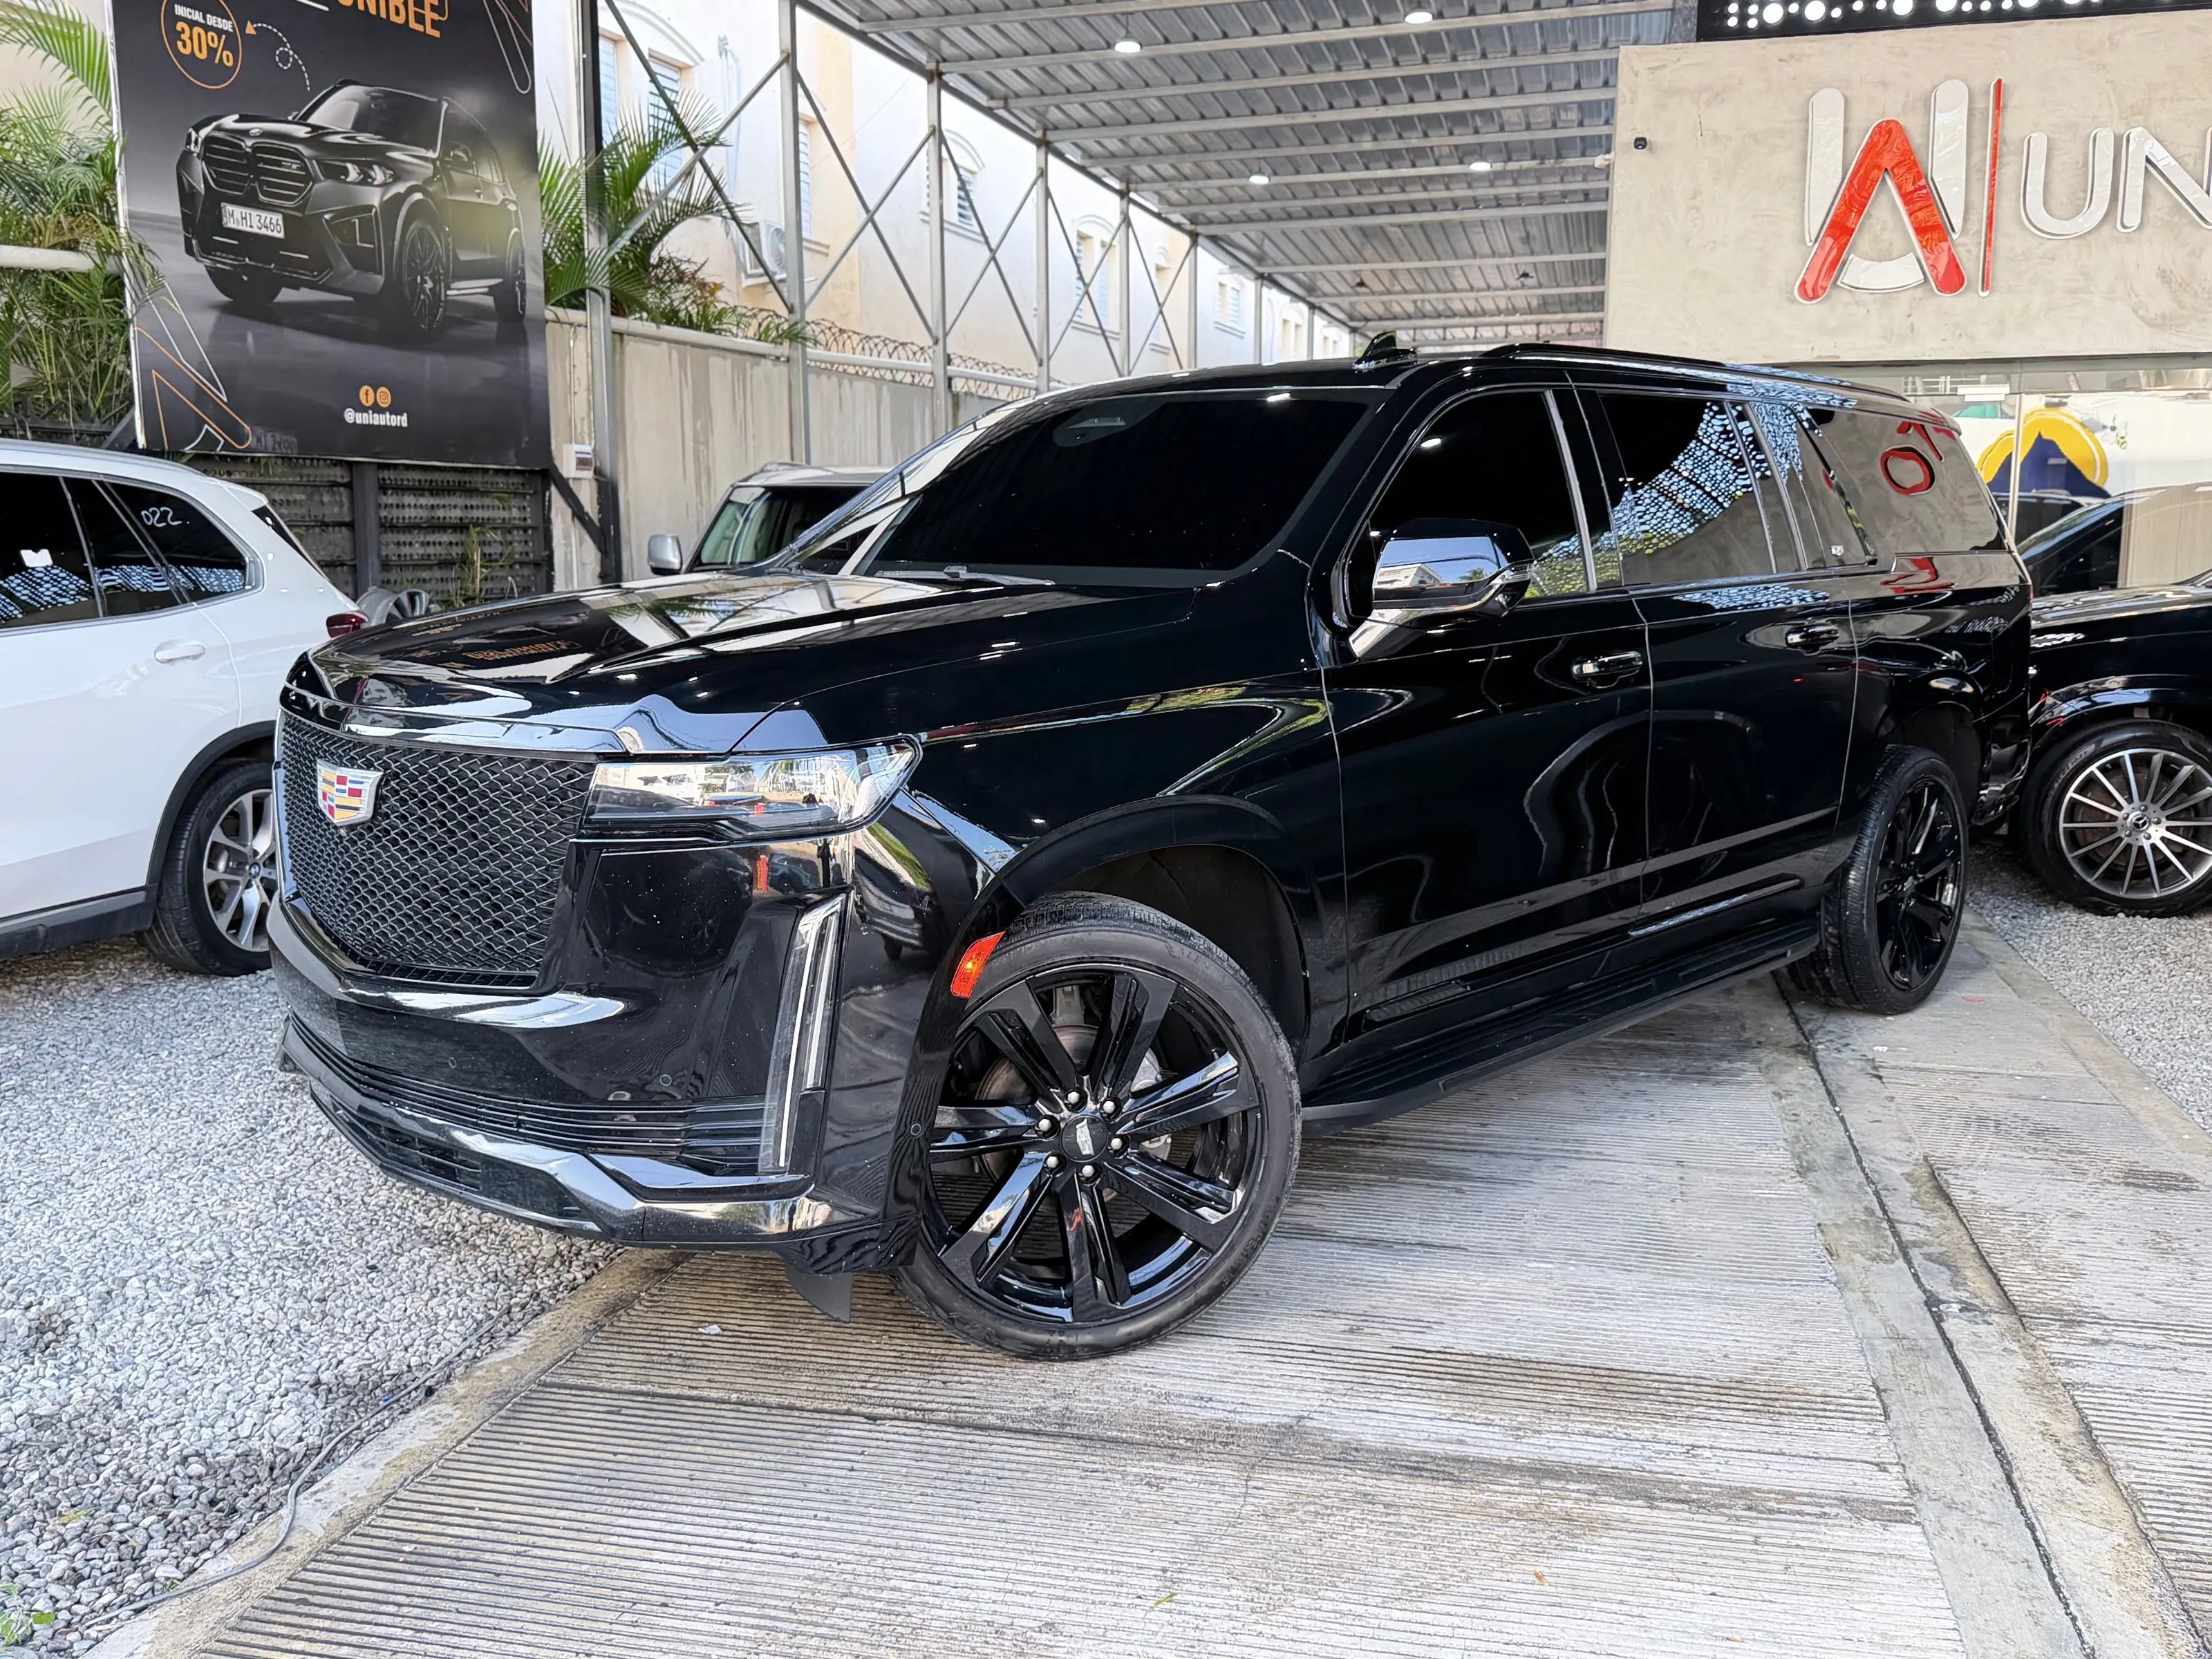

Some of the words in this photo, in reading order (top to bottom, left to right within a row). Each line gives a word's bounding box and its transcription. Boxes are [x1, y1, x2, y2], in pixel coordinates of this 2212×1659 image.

[174, 4, 206, 24] INICIAL
[206, 14, 234, 32] DESDE
[337, 0, 441, 39] BLE
[176, 21, 234, 67] 30%
[256, 214, 282, 234] 3466
[344, 407, 409, 427] @uniautord
